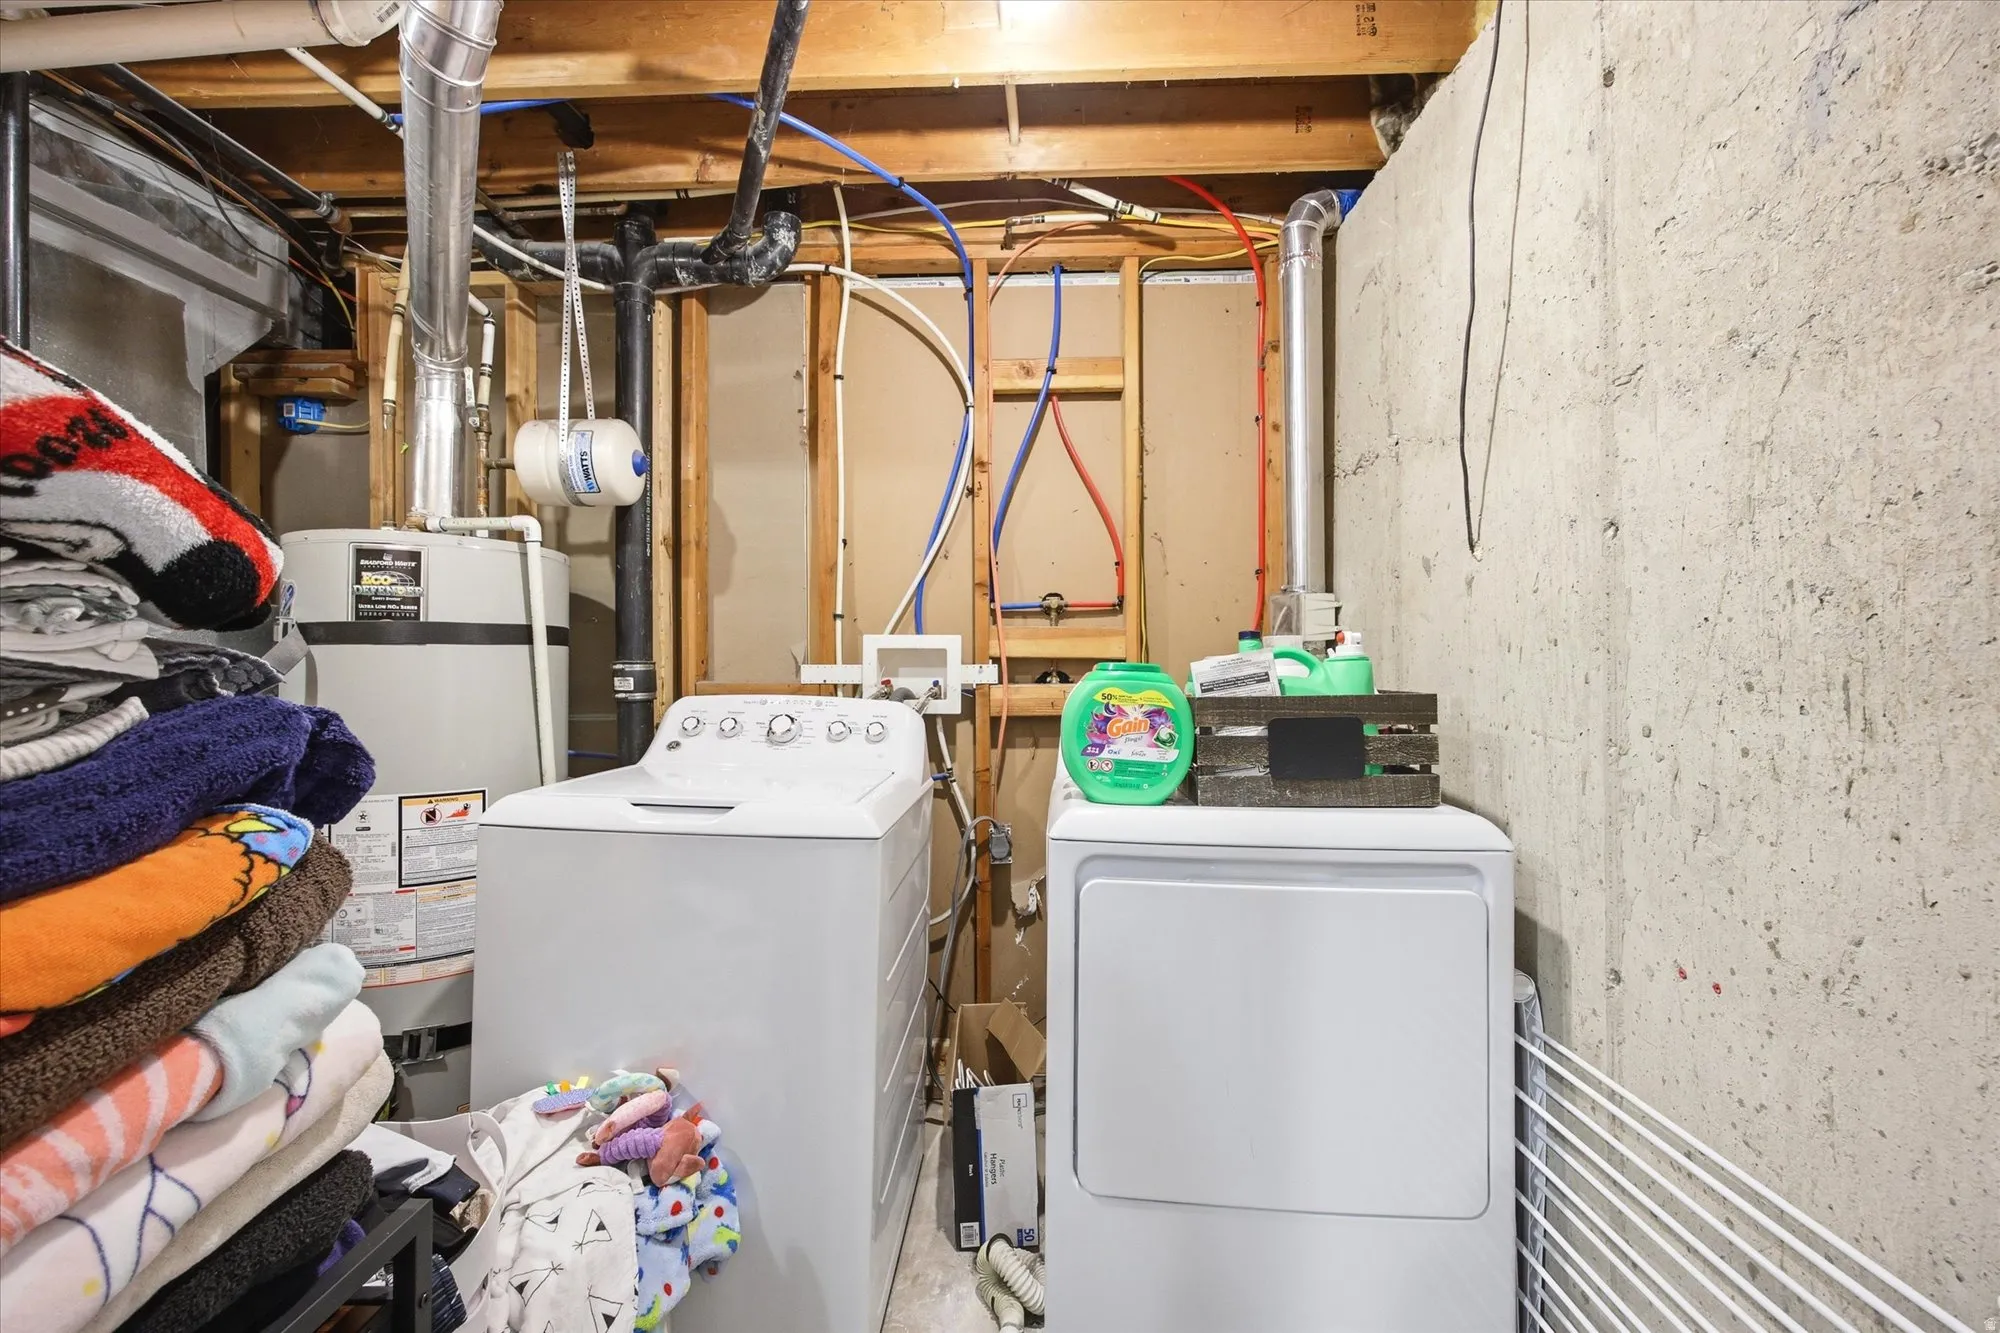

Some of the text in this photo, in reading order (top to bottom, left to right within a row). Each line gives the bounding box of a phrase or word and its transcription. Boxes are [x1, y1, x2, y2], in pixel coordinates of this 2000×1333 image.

[580, 450, 592, 481] WATTS
[353, 585, 424, 597] DEFENDER
[1107, 717, 1150, 738] Gain
[989, 1153, 998, 1185] Hangers
[1023, 1228, 1035, 1241] 50
